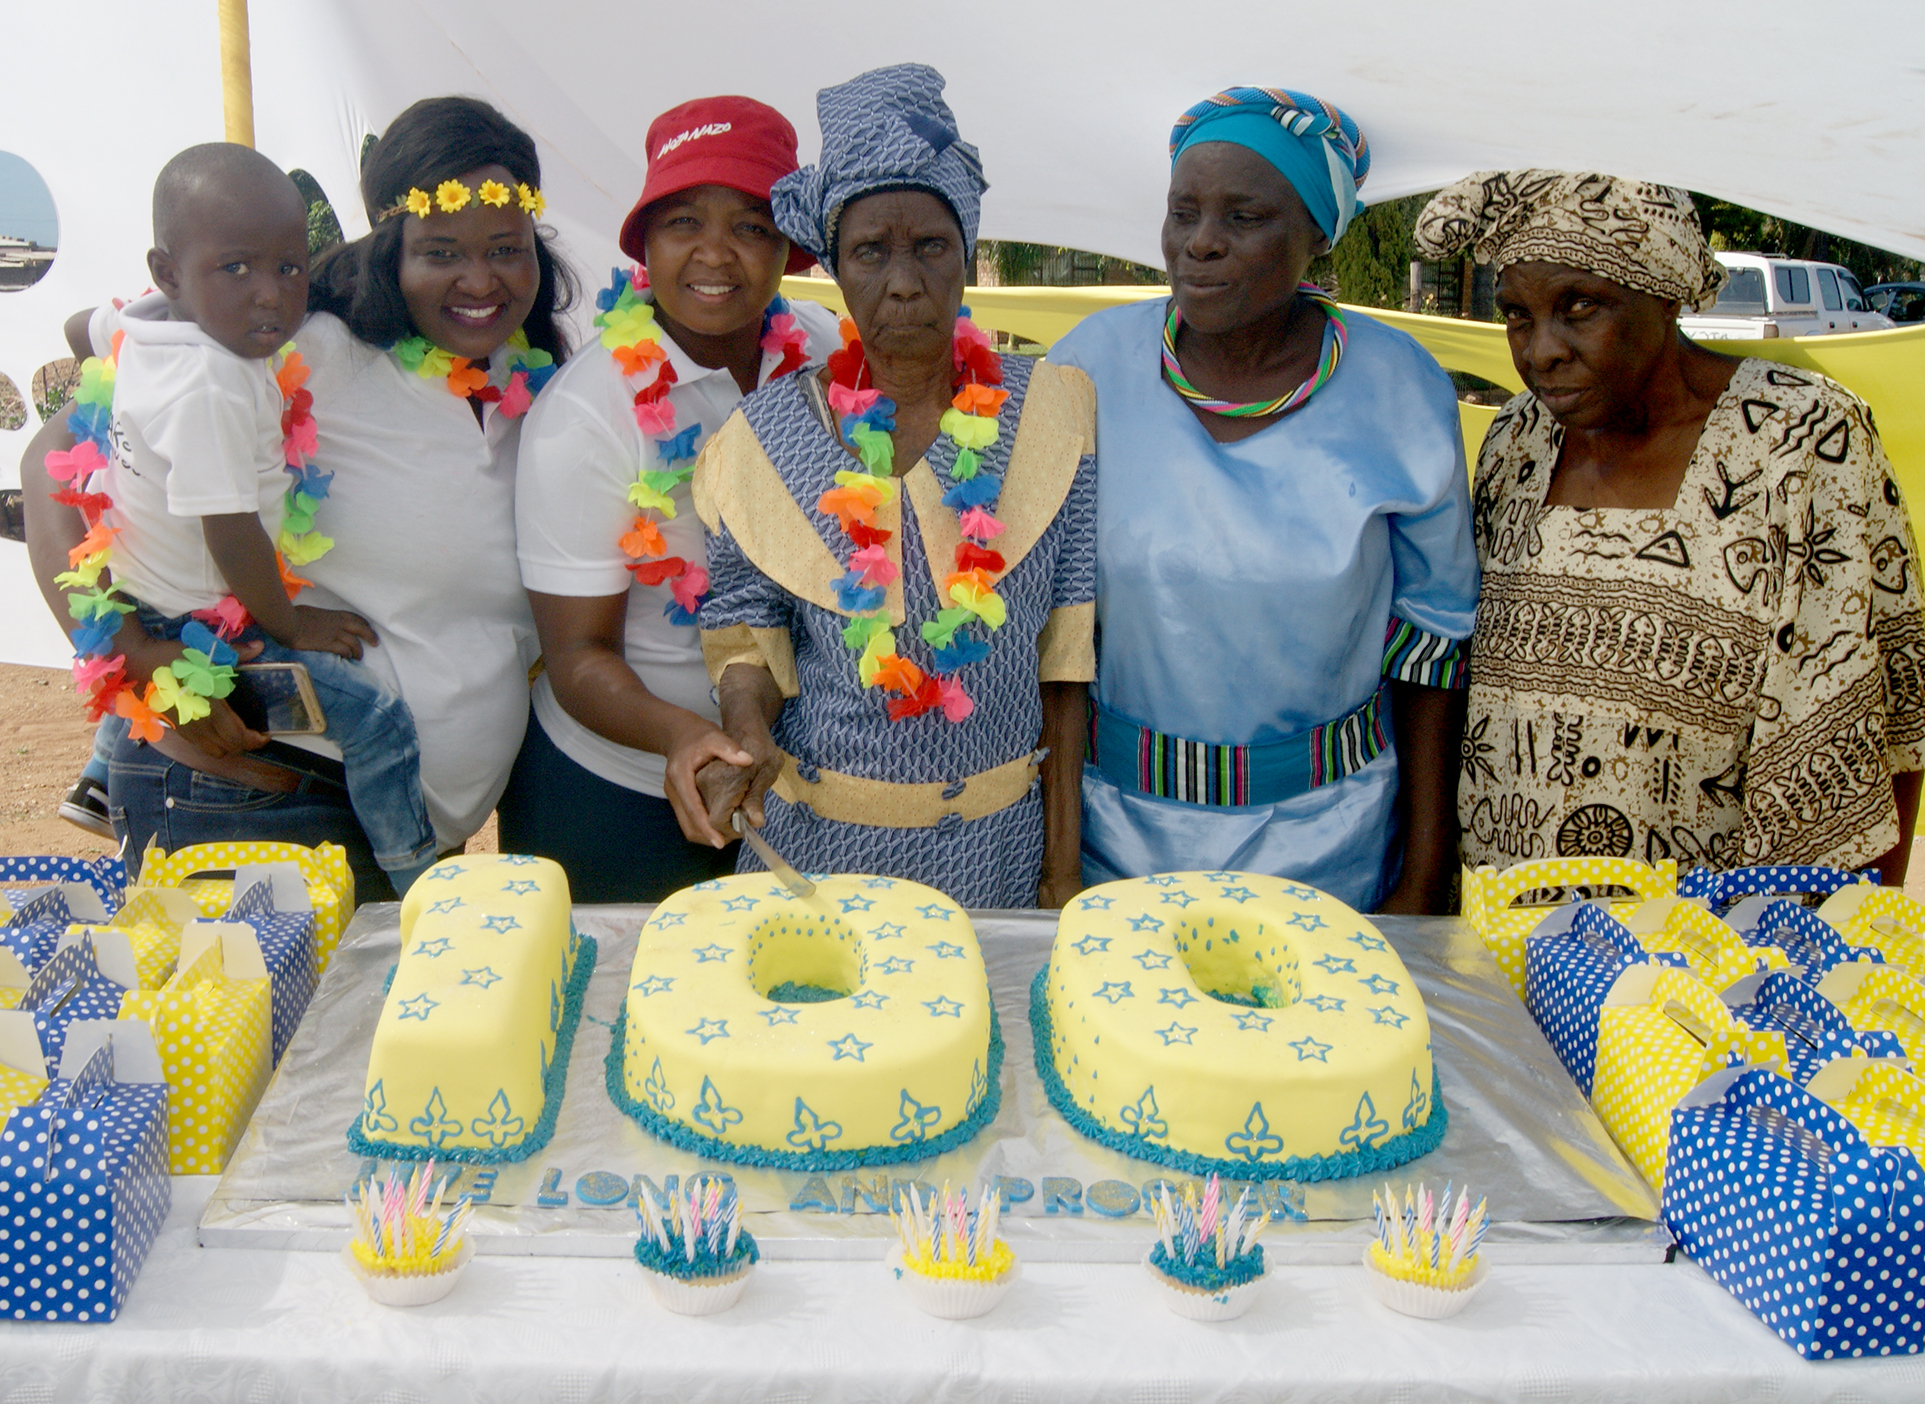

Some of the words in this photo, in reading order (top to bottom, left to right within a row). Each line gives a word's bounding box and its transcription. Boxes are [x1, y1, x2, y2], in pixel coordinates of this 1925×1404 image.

[687, 122, 732, 142] NAZO
[537, 1167, 739, 1210] LONG
[789, 1174, 939, 1215] AND
